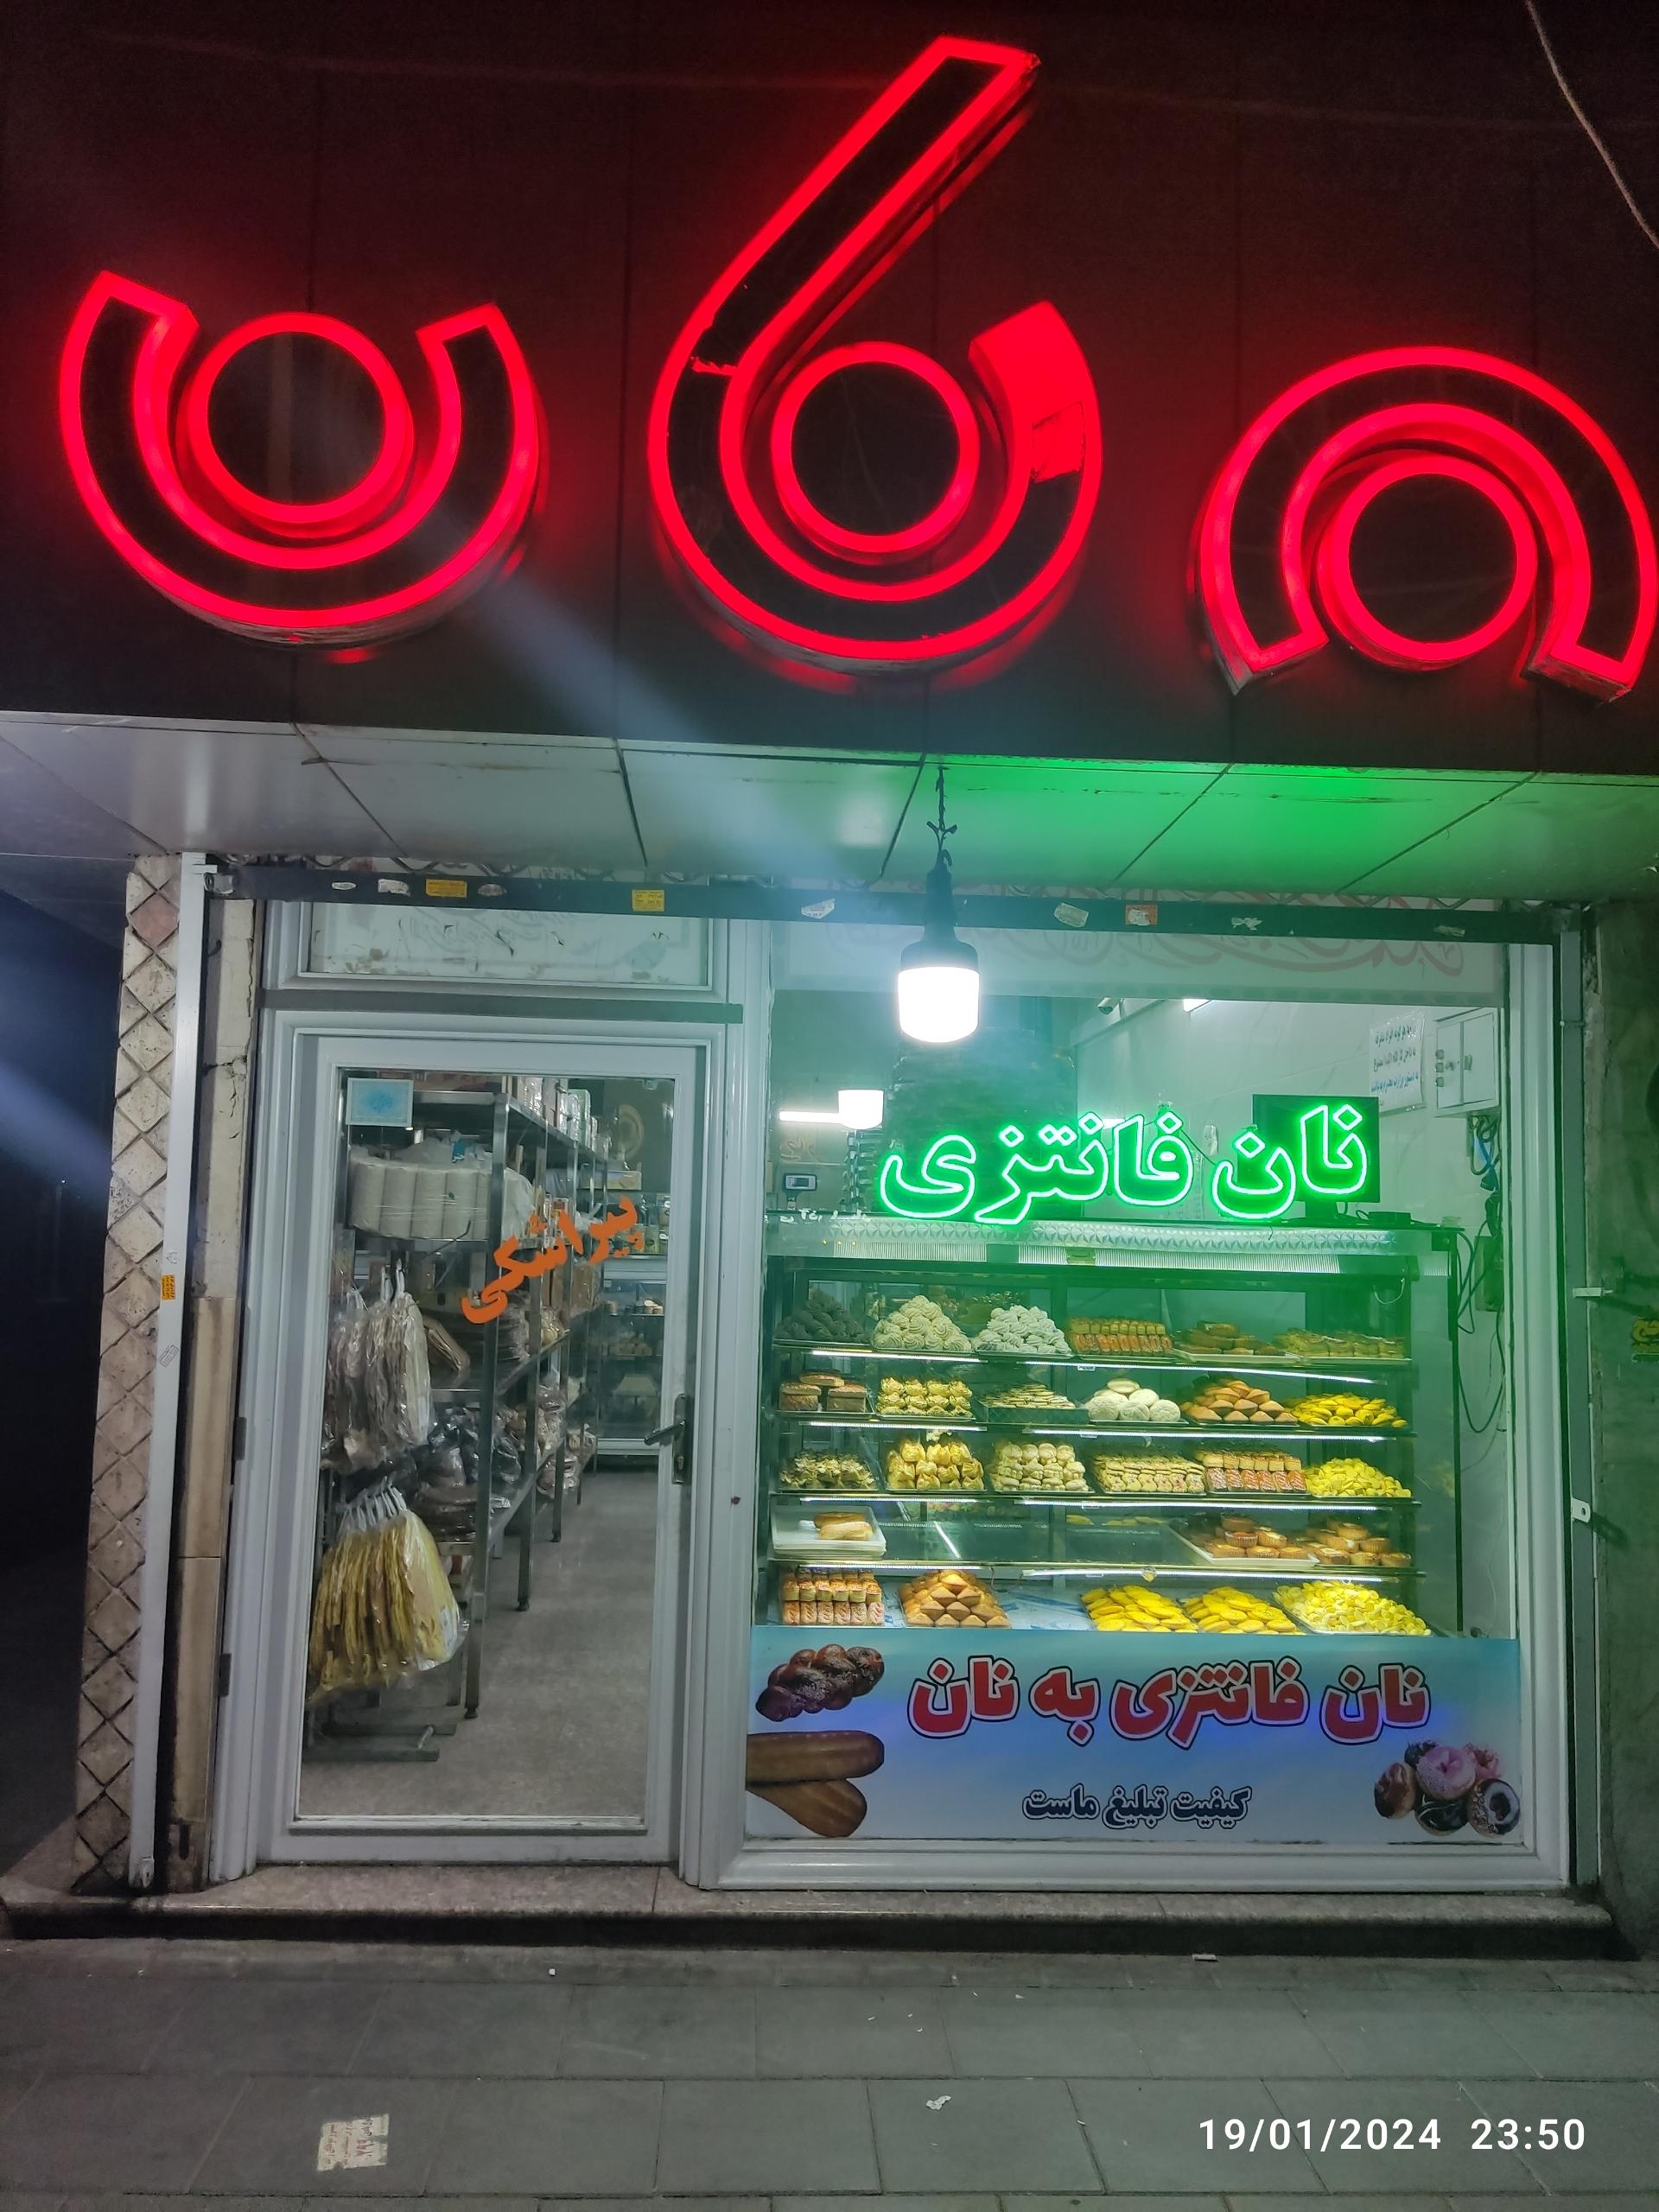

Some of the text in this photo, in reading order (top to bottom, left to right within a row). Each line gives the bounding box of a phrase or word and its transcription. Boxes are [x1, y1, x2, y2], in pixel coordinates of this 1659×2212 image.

[880, 1103, 1368, 1225] نان فانتزی
[461, 1195, 645, 1324] پیراشکی
[907, 1655, 1431, 1750] نان فانتزی به نان
[1022, 1783, 1252, 1829] کیفیت تبلیغ ماست
